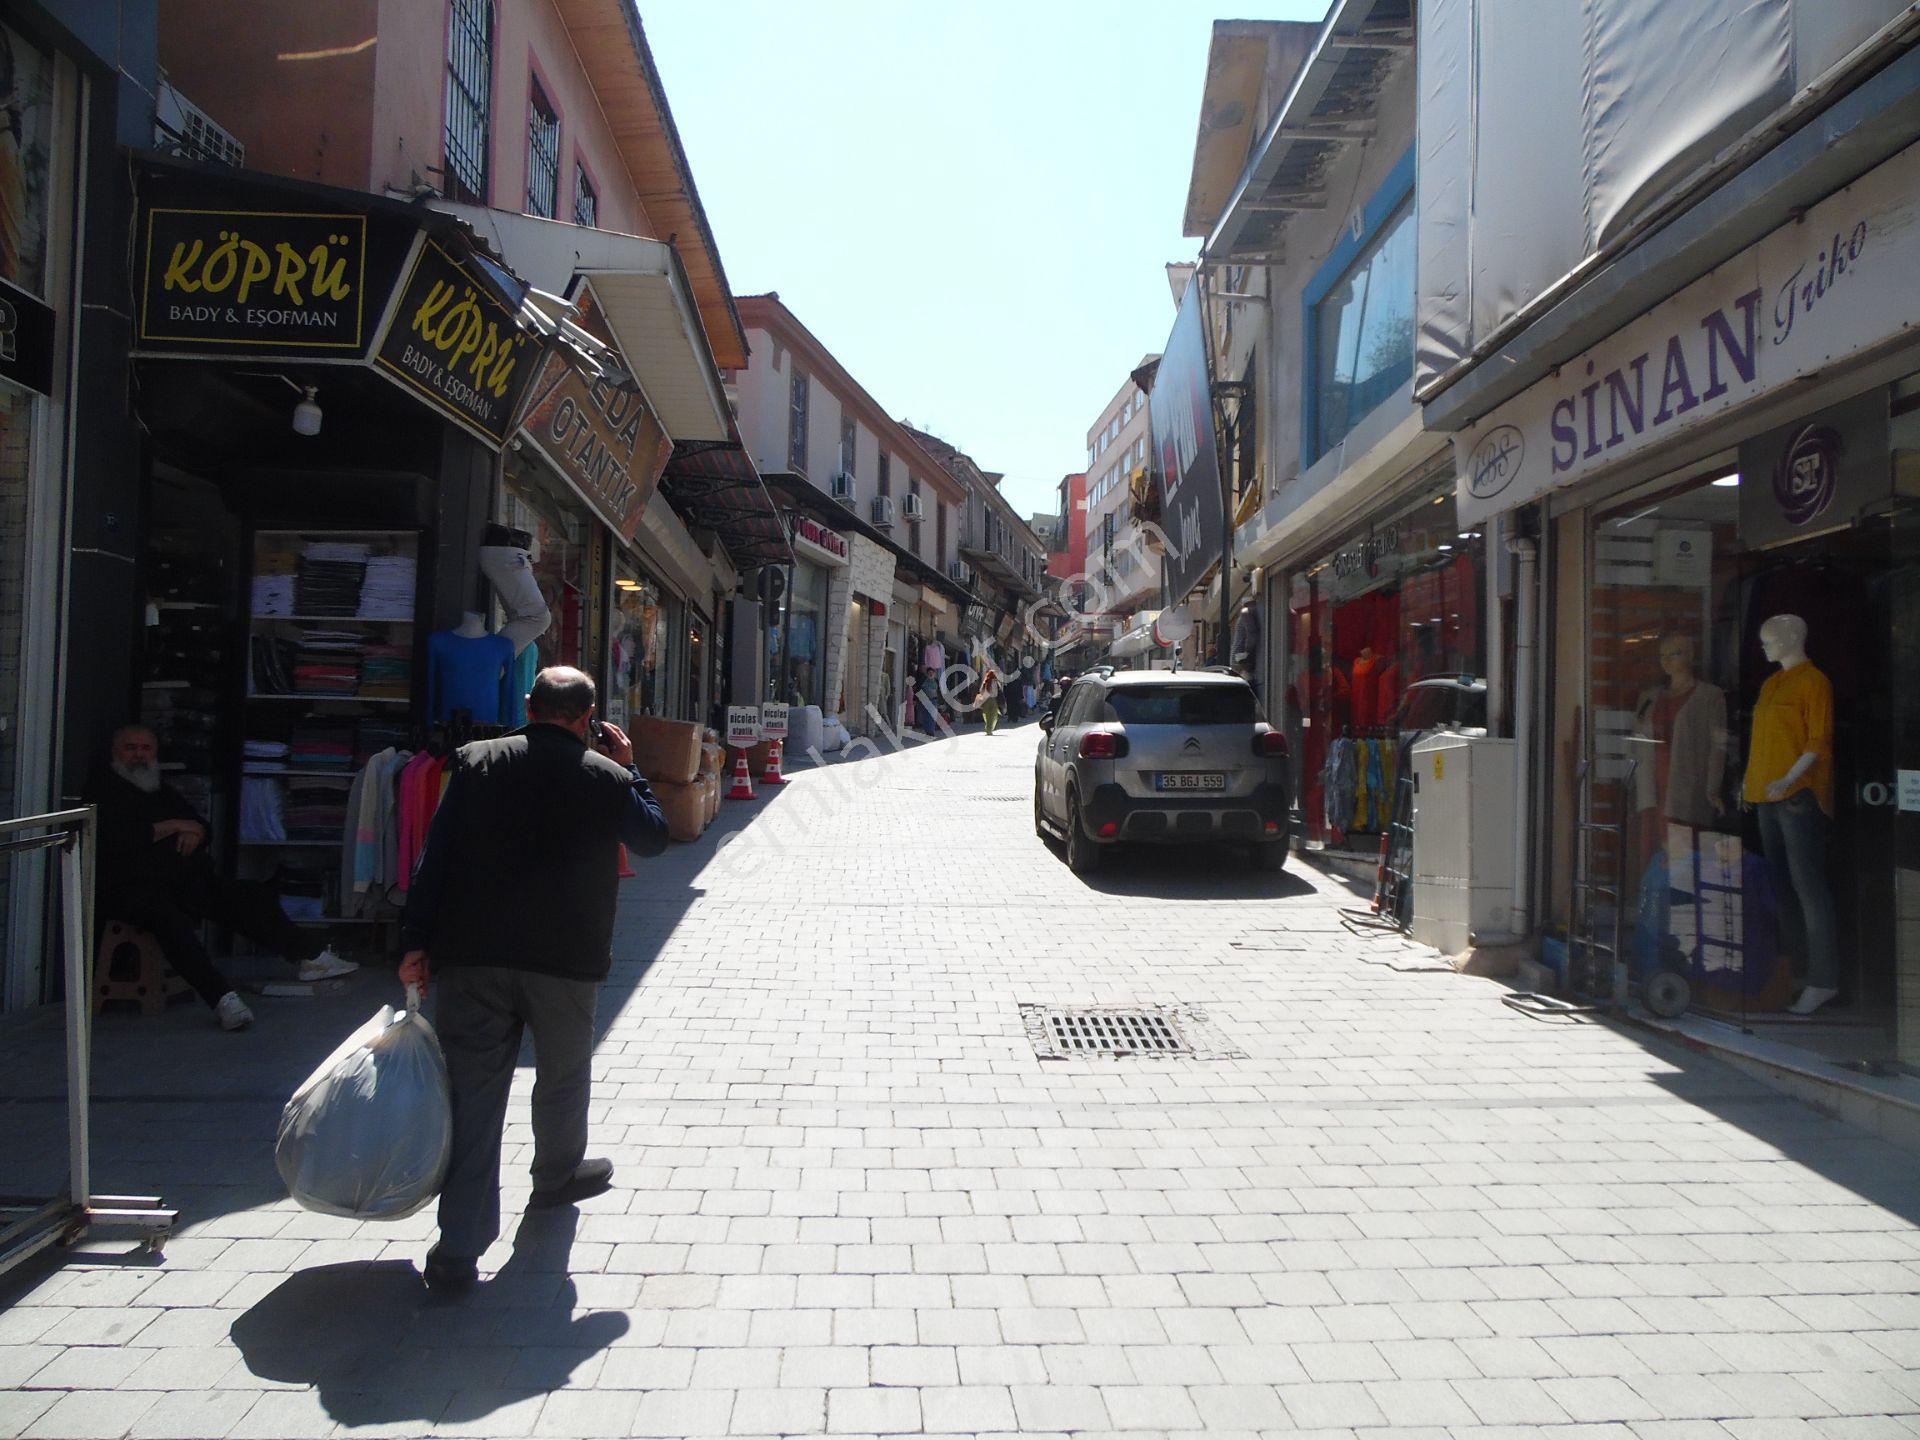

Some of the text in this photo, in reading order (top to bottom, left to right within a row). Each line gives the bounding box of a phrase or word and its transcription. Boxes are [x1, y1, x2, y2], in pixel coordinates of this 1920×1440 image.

[164, 231, 350, 305] KÖPRÜ
[170, 305, 337, 328] BADY & EŞOFMAN
[412, 279, 525, 398] KÖPRÜ
[1551, 221, 1867, 474] SİNAN Triko
[401, 344, 492, 421] BADY & EŞOFMAN
[551, 396, 638, 521] OTANTİK
[730, 713, 756, 724] nicolas
[764, 708, 787, 719] nicolas
[1163, 775, 1223, 787] 35 BGJ 559
